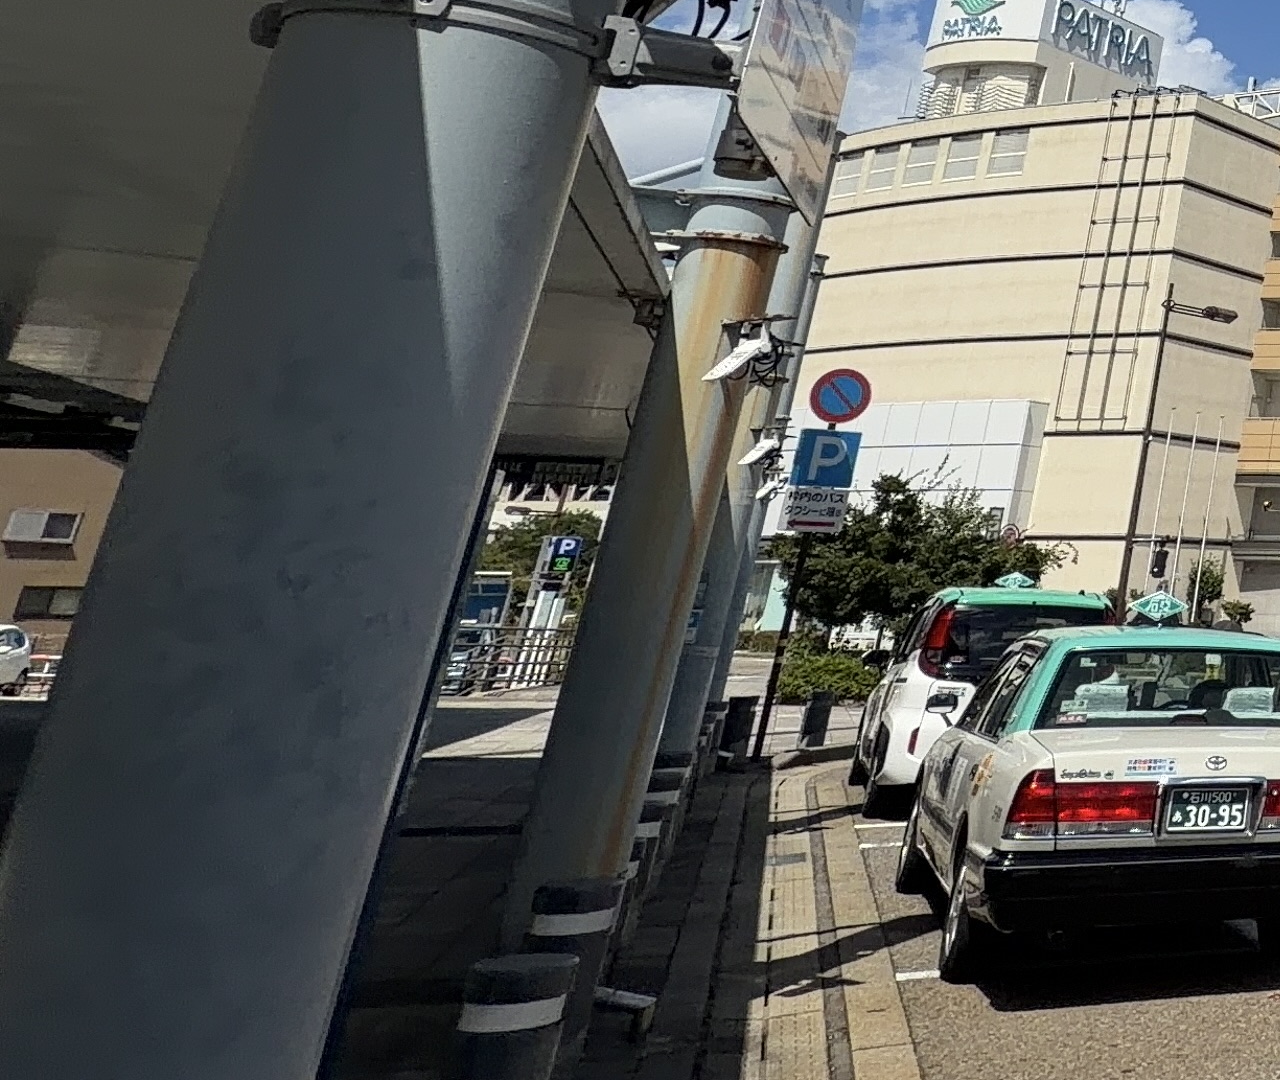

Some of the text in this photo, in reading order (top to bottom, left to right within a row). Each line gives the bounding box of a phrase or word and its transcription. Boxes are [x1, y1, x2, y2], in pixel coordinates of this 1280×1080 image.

[942, 16, 1002, 40] PATRIA
[807, 435, 847, 480] P
[558, 539, 576, 555] P
[1171, 803, 1243, 827] あ 30-95
